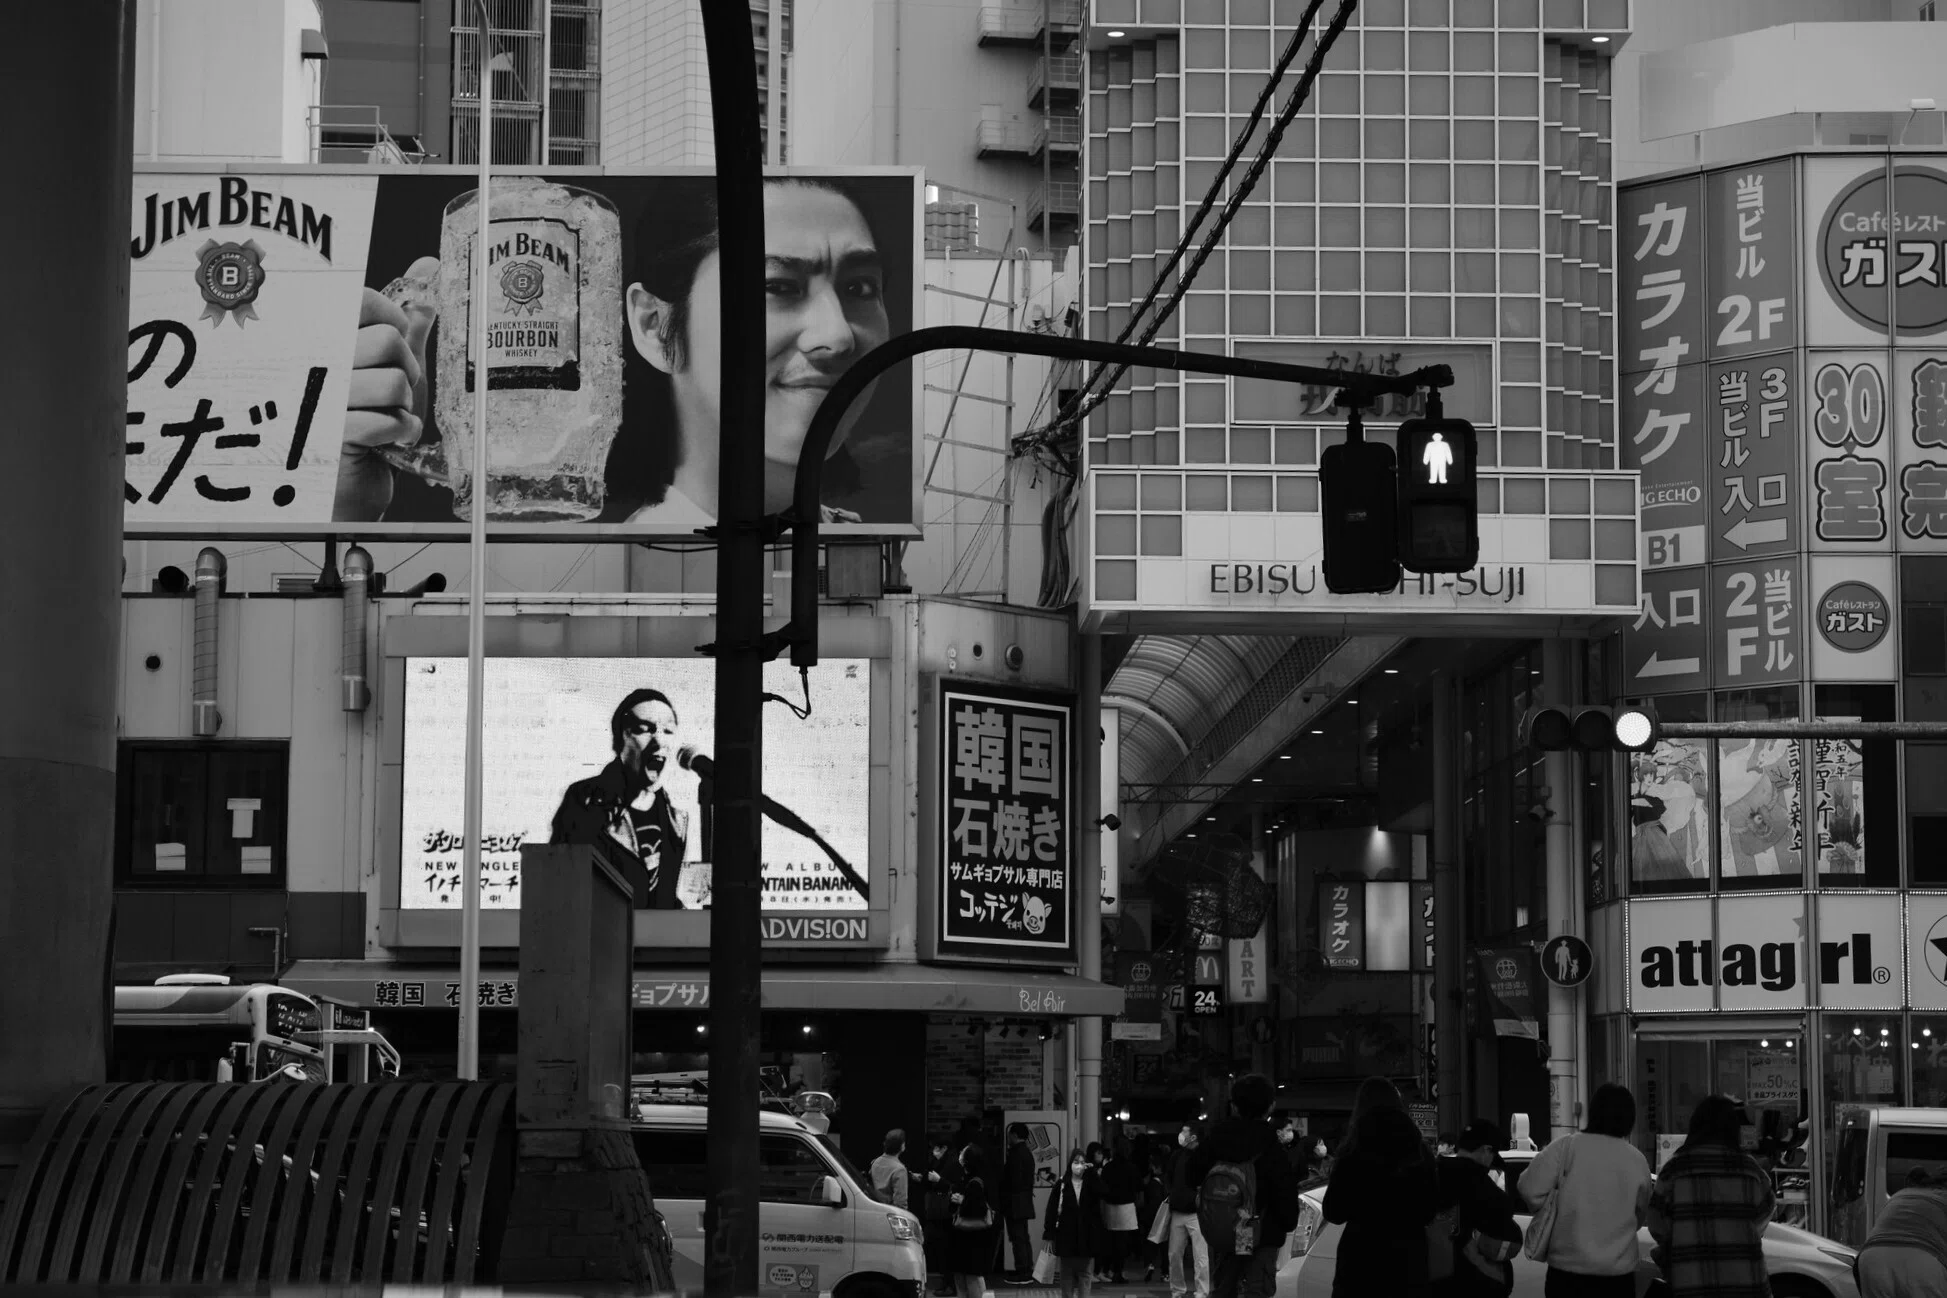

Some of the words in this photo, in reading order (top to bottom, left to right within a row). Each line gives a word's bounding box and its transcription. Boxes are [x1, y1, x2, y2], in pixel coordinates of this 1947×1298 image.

[131, 192, 211, 259] JIM
[218, 176, 333, 266] BEAM
[1736, 174, 1765, 279] 当ビル
[488, 240, 510, 266] IM
[516, 233, 570, 275] BEAM
[1841, 237, 1947, 288] ガス
[488, 331, 559, 348] BOURBON
[524, 321, 559, 330] STRAIGHT
[1633, 202, 1691, 466] カラオケ
[1716, 294, 1786, 346] 2F
[505, 349, 538, 358] WHISKEY
[1719, 370, 1750, 469] 当ビル
[1758, 367, 1789, 438] 3F
[1814, 362, 1886, 448] 30
[125, 367, 328, 507] だ!
[1641, 491, 1656, 506] IG
[1658, 485, 1701, 503] ECHO
[1720, 473, 1788, 515] 入口
[1814, 454, 1888, 542] 室
[1648, 533, 1681, 566] B1
[1632, 588, 1701, 632] 入口
[1725, 572, 1759, 676] 2F
[1764, 568, 1795, 672] 当ビル
[1826, 612, 1884, 633] ガスト
[955, 705, 1060, 800] 韓国
[1834, 742, 1850, 778] 和五年
[952, 798, 1062, 862] 石焼き
[424, 873, 519, 893] イノチマーチ
[425, 861, 457, 871] NEW
[481, 861, 519, 871] NGLE
[761, 877, 800, 891] NTAIN
[786, 862, 853, 872] ALBU
[950, 861, 1064, 890] サムギョプサル専門店
[959, 889, 1018, 923] コッテジ
[1331, 885, 1350, 953] カラオケ
[374, 980, 426, 1006] 韓国
[1018, 988, 1042, 1013] Bel
[1194, 1006, 1218, 1014] OPEN
[776, 1233, 845, 1244] 関西電力送配電
